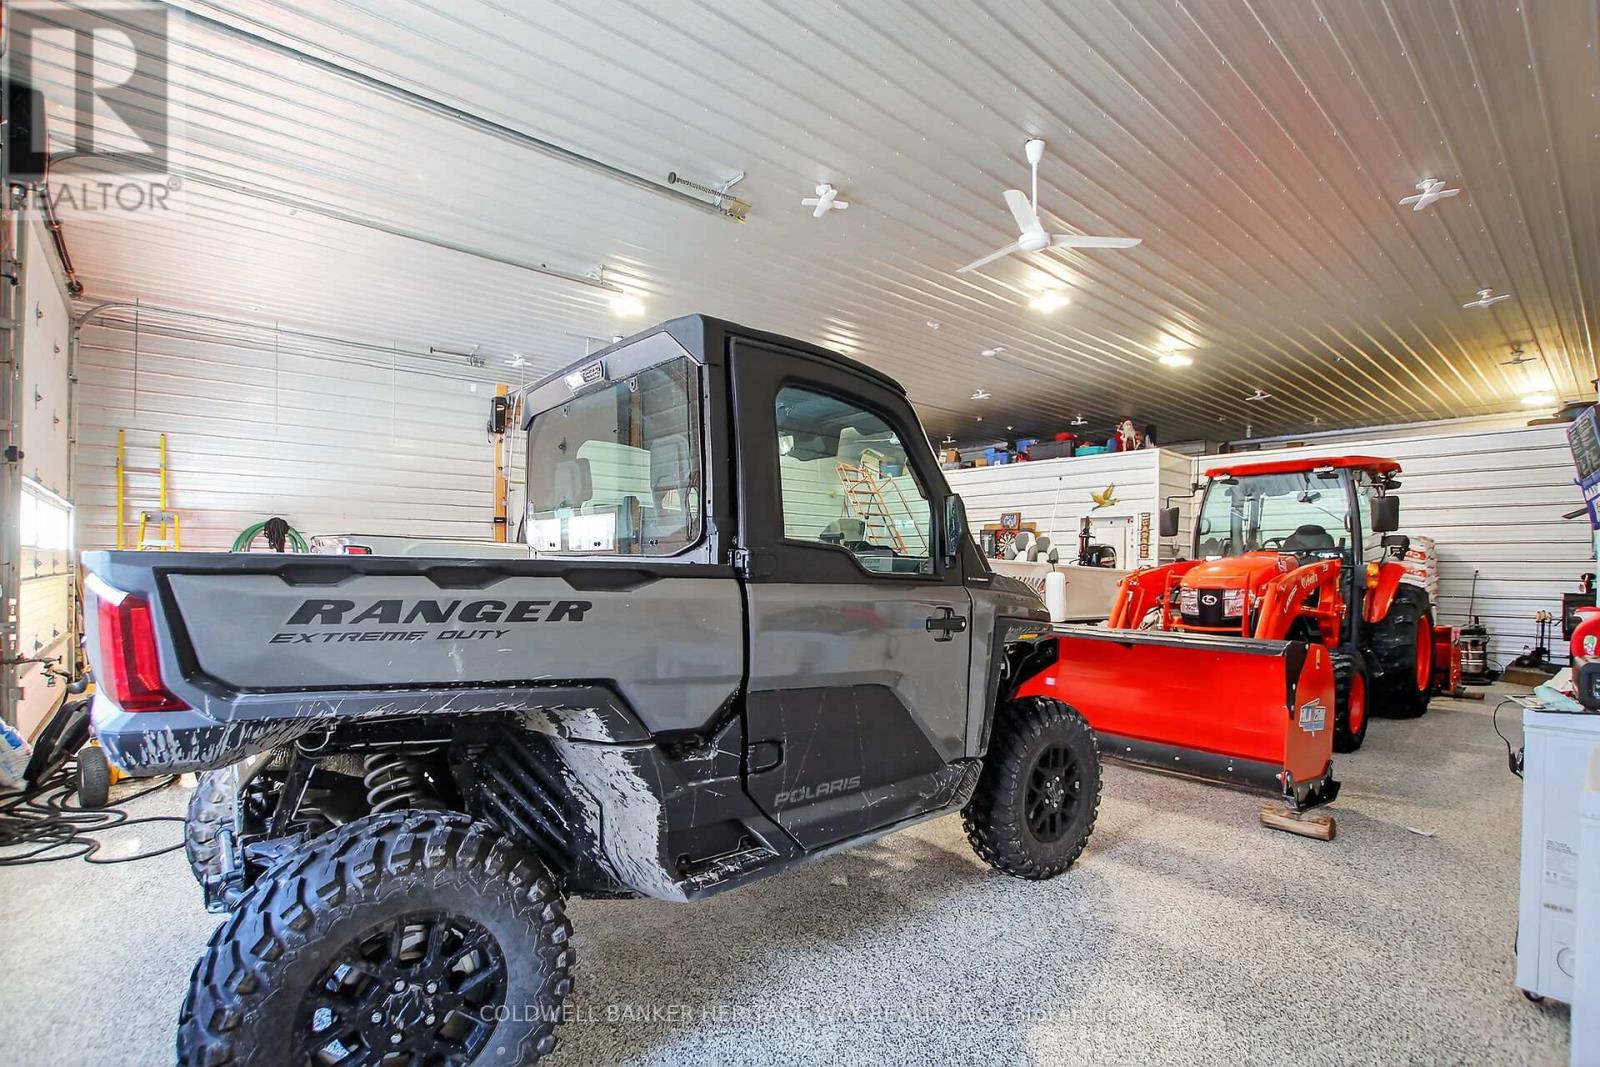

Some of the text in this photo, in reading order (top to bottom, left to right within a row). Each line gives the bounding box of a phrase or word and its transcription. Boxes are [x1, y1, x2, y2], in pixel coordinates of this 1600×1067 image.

[286, 599, 592, 625] RANGER
[268, 629, 510, 644] EXTREME DUTY
[774, 776, 860, 807] POLARIS
